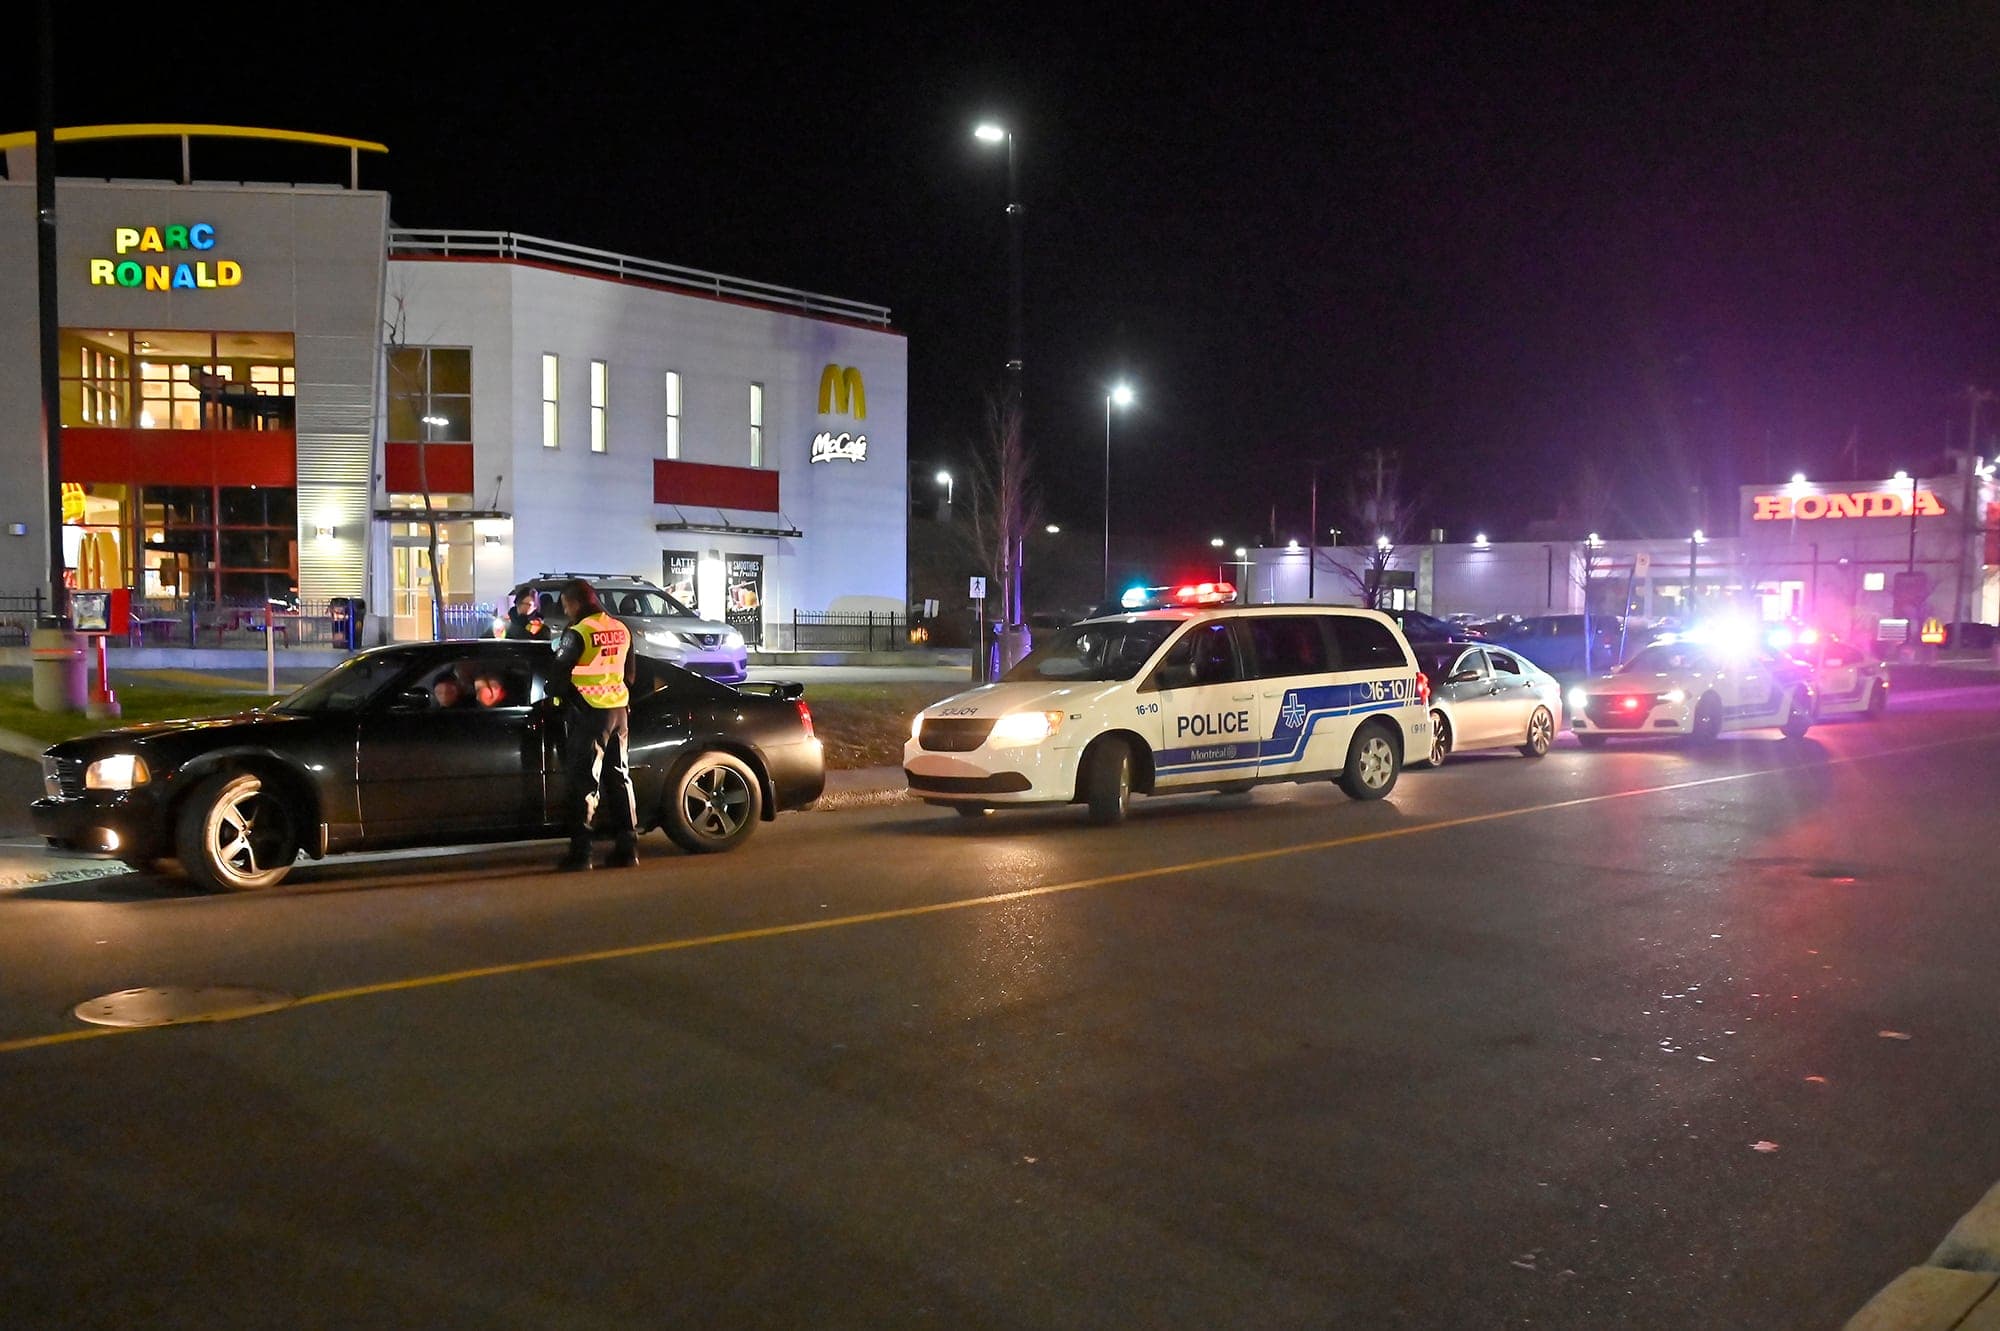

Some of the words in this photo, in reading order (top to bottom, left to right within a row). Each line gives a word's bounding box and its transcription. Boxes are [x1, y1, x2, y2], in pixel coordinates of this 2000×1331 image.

[115, 222, 216, 255] PARC
[90, 258, 243, 292] RONALD
[1753, 490, 1946, 521] HONDA
[670, 556, 696, 568] LATTE
[732, 560, 760, 572] SMOOTHIES
[593, 631, 625, 646] POLICE
[1369, 680, 1404, 700] 16-10
[1136, 702, 1159, 716] 16-10
[1176, 710, 1249, 738] POLICE
[1190, 746, 1227, 761] Montréal
